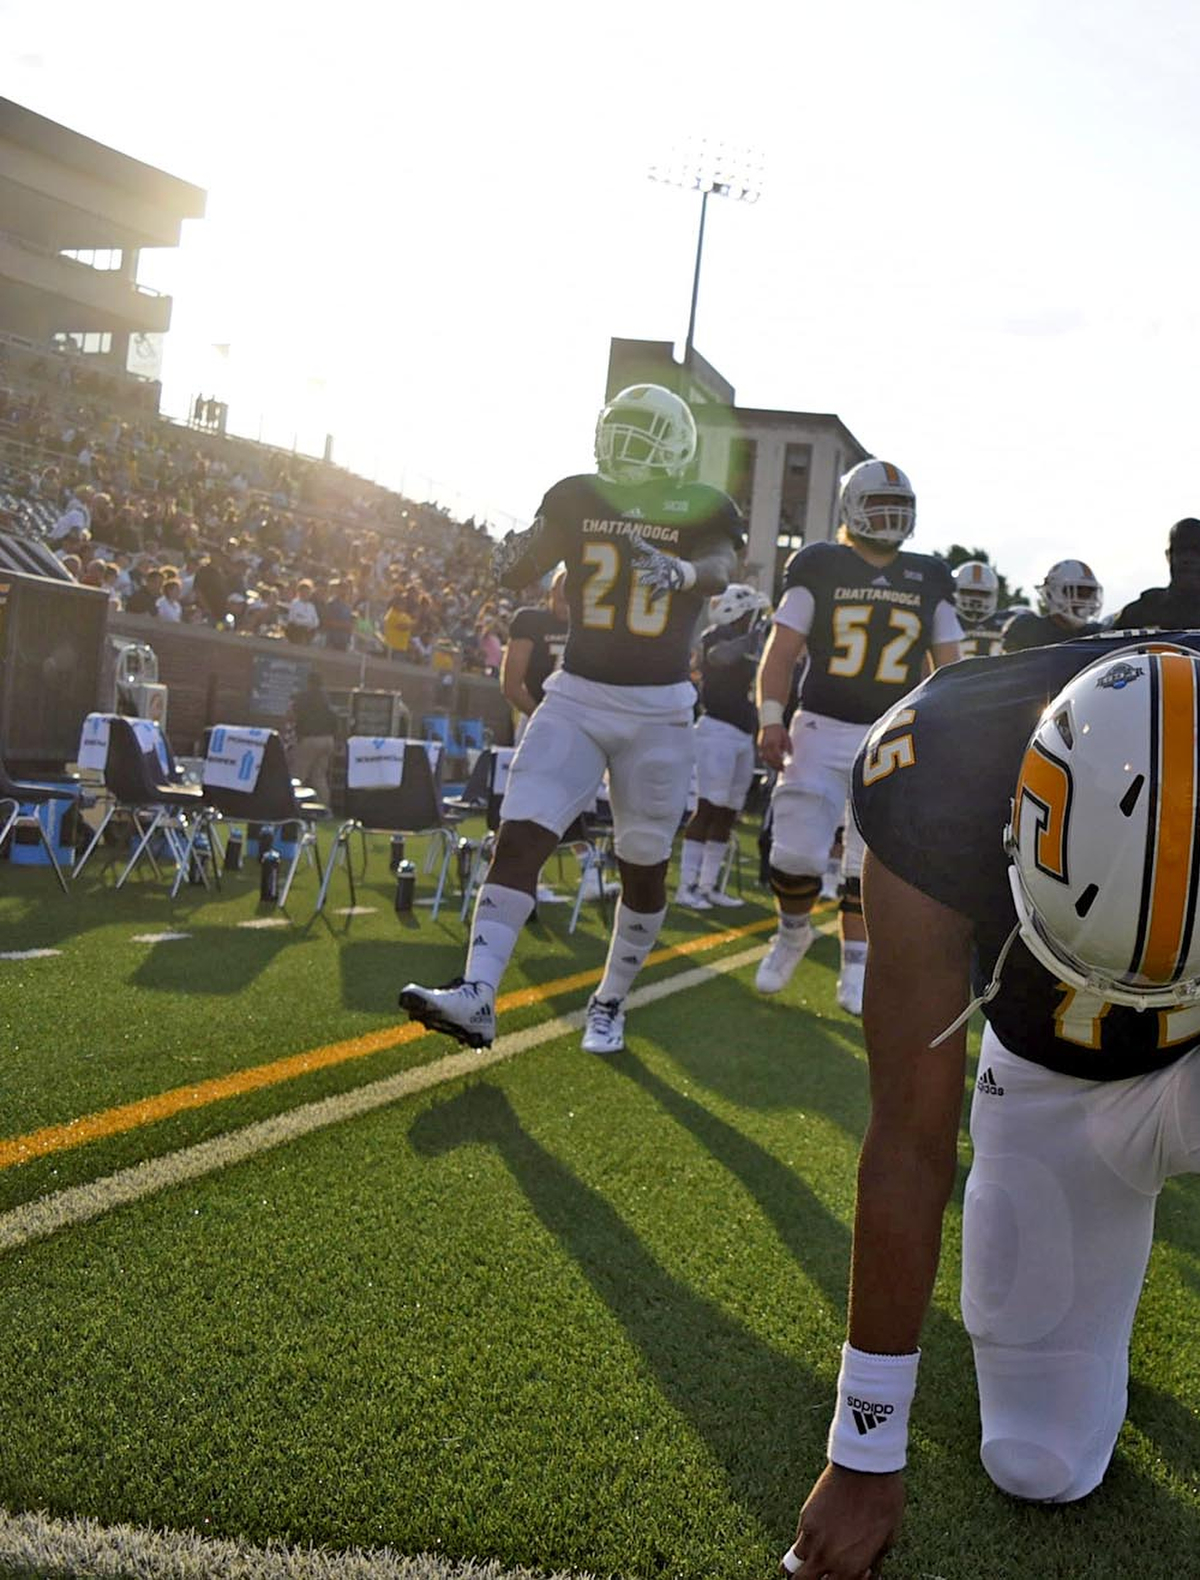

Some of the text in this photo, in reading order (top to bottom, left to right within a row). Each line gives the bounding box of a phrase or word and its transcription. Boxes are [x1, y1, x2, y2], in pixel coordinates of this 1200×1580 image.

[582, 518, 680, 543] CHATTANOOGA
[834, 587, 921, 607] CHATTANOOGA
[828, 604, 922, 684] 52
[847, 1395, 894, 1415] adidas
